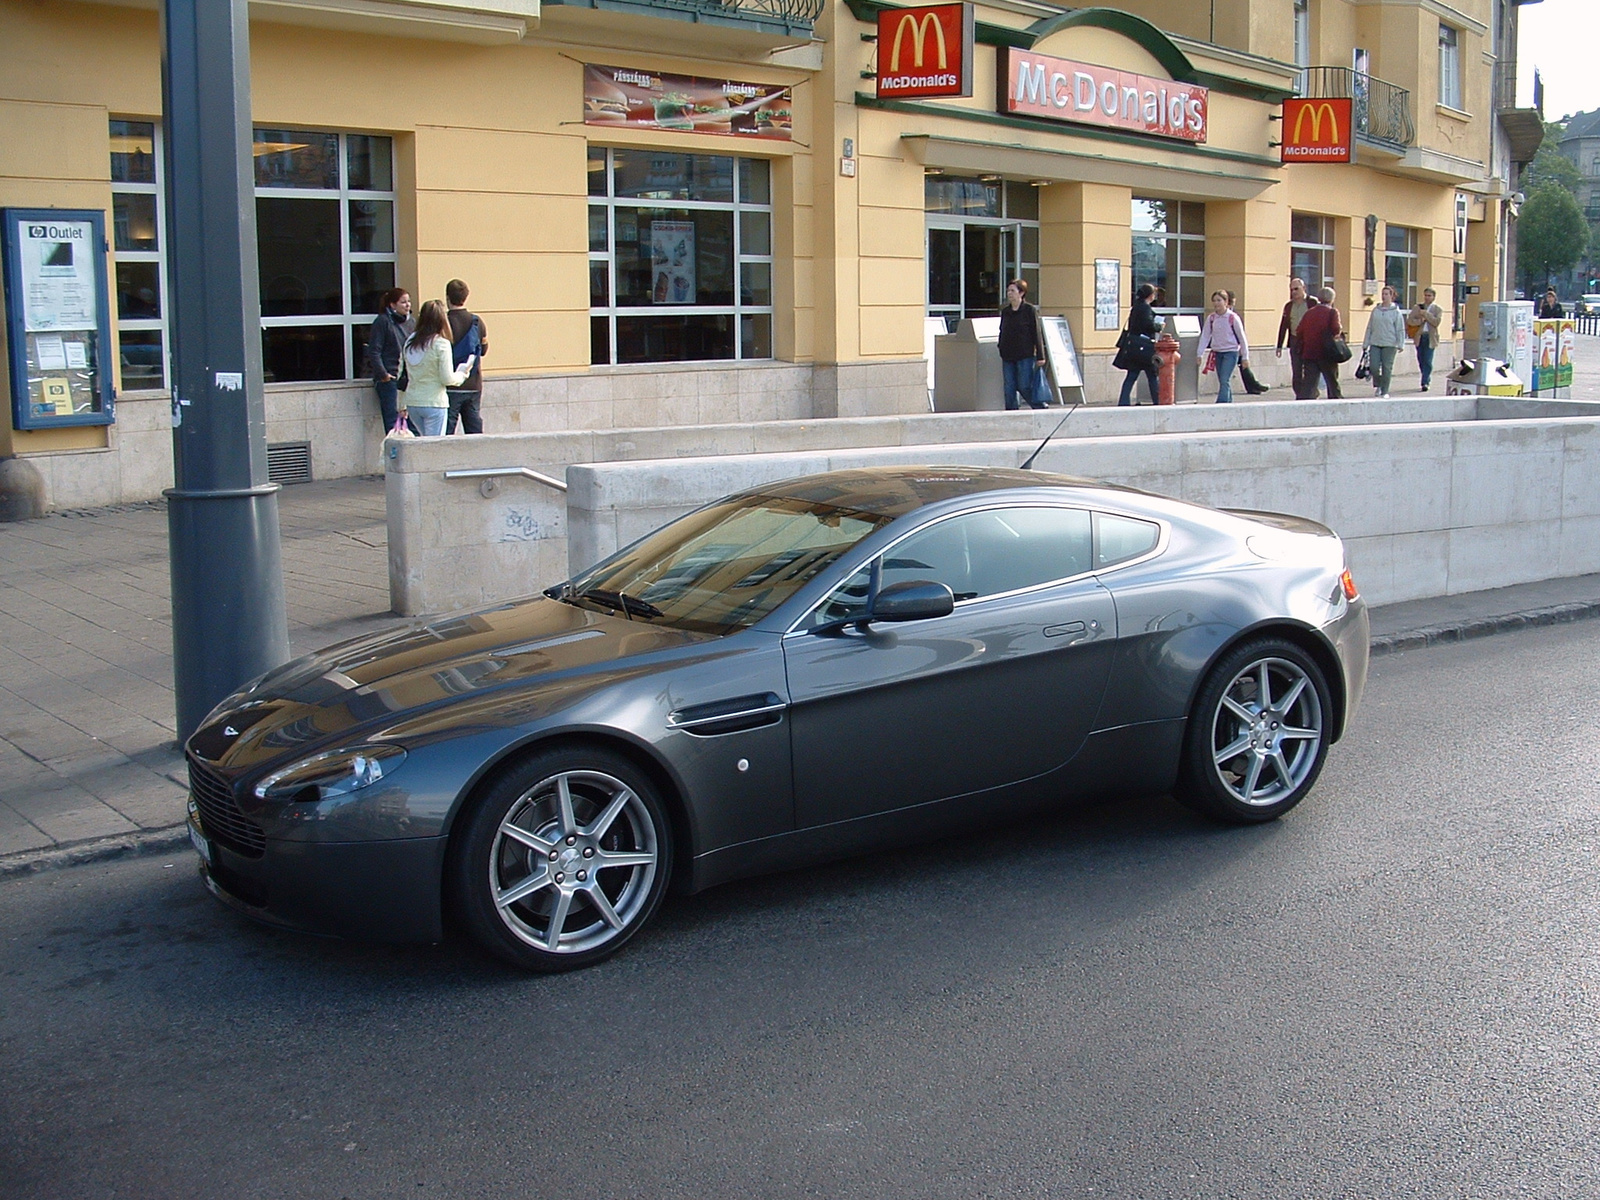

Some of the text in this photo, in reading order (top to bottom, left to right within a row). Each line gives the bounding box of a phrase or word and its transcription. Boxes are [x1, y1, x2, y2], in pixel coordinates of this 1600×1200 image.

[880, 73, 957, 90] McDonald's
[1015, 60, 1204, 134] McDonald's
[1284, 146, 1346, 156] McDonald's
[49, 226, 83, 239] Outlet
